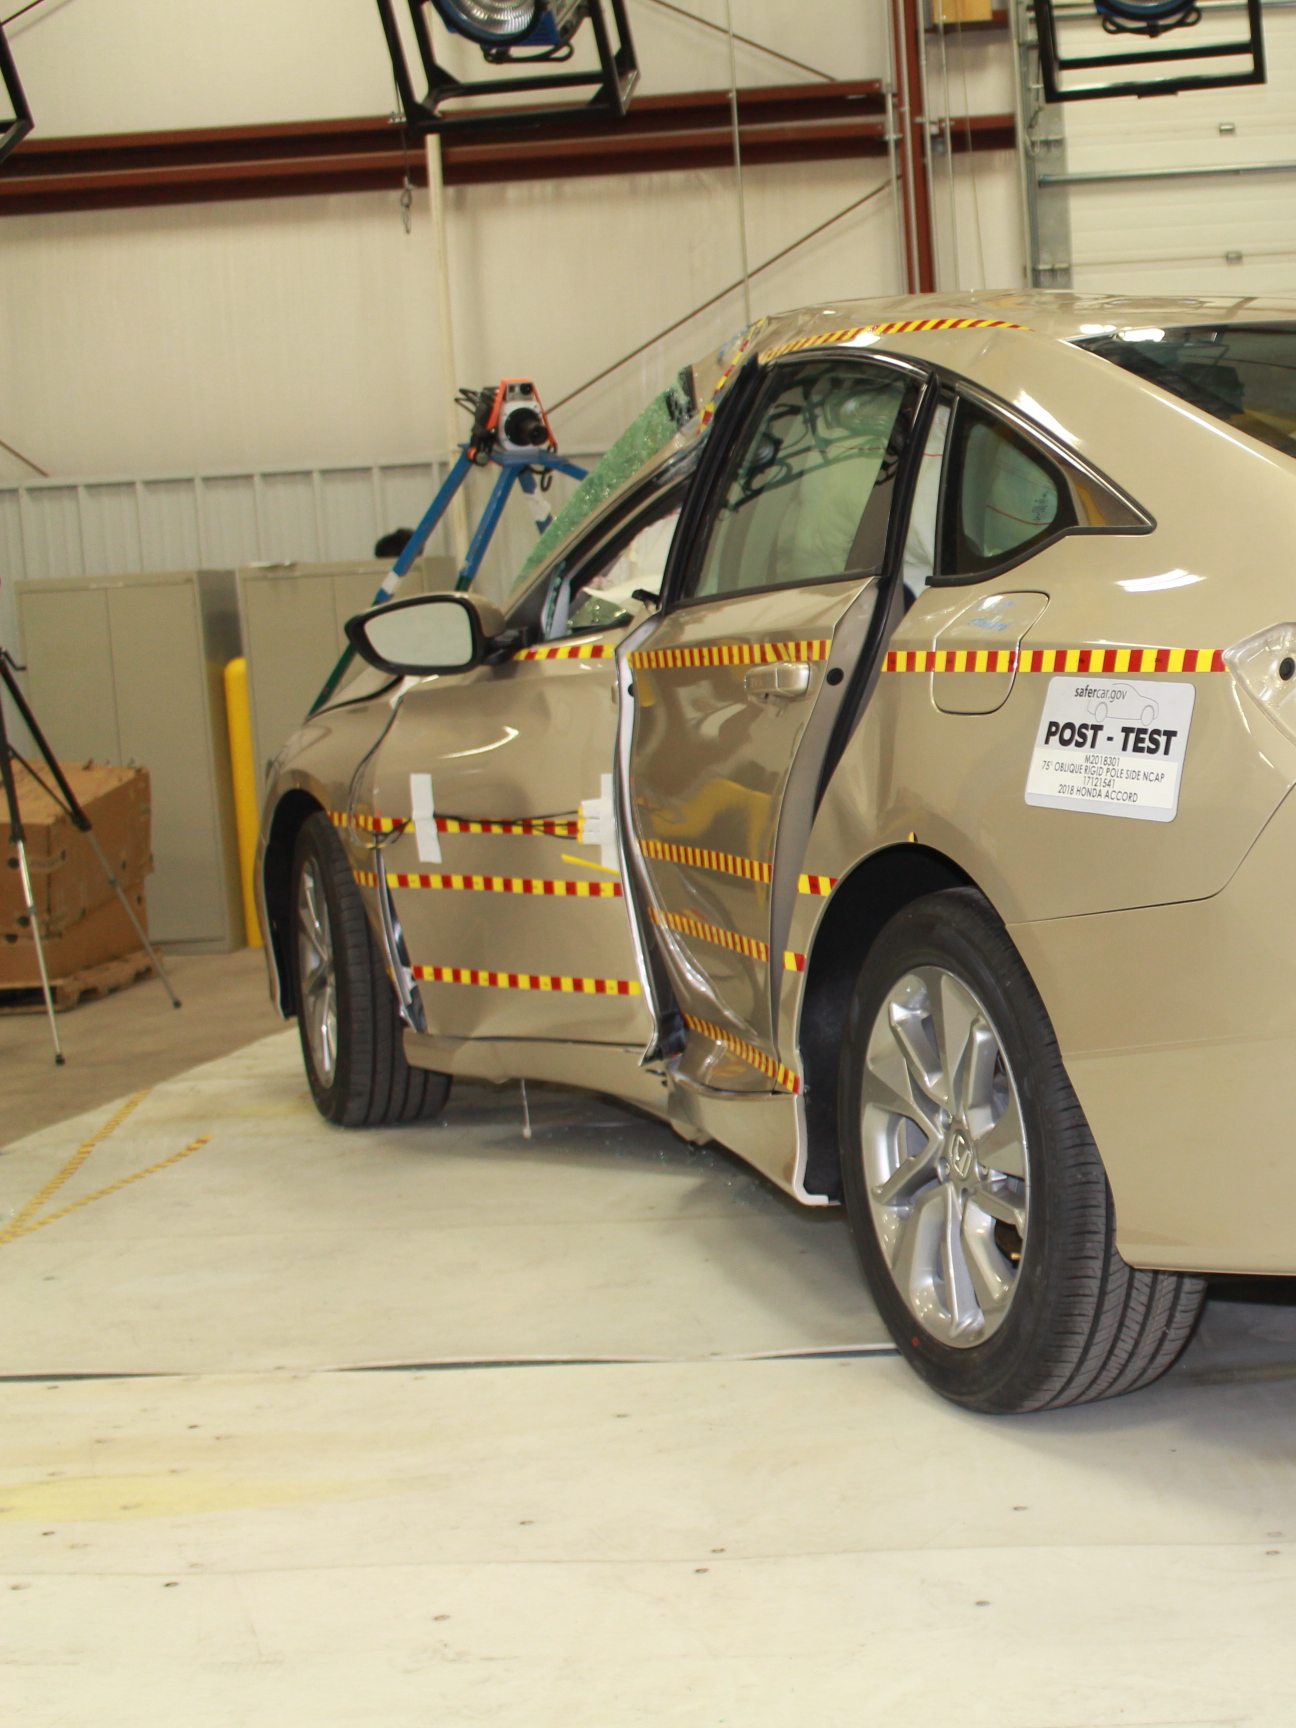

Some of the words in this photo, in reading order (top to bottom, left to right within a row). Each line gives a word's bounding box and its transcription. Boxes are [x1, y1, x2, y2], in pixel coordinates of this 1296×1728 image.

[1075, 685, 1128, 702] safercar.gov
[1044, 720, 1104, 749] POST
[1121, 727, 1178, 756] TEST
[1084, 754, 1120, 767] M2018301
[1054, 762, 1084, 774] OBLIQUE
[1084, 765, 1104, 777] RIGID
[1104, 768, 1124, 779] POLE
[1124, 769, 1141, 781] SIDE
[1142, 771, 1166, 783] NCAP
[1082, 776, 1116, 789] 17121541
[1057, 783, 1075, 795] 2018
[1075, 786, 1102, 799] HONDA
[1104, 791, 1138, 803] ACCORD
